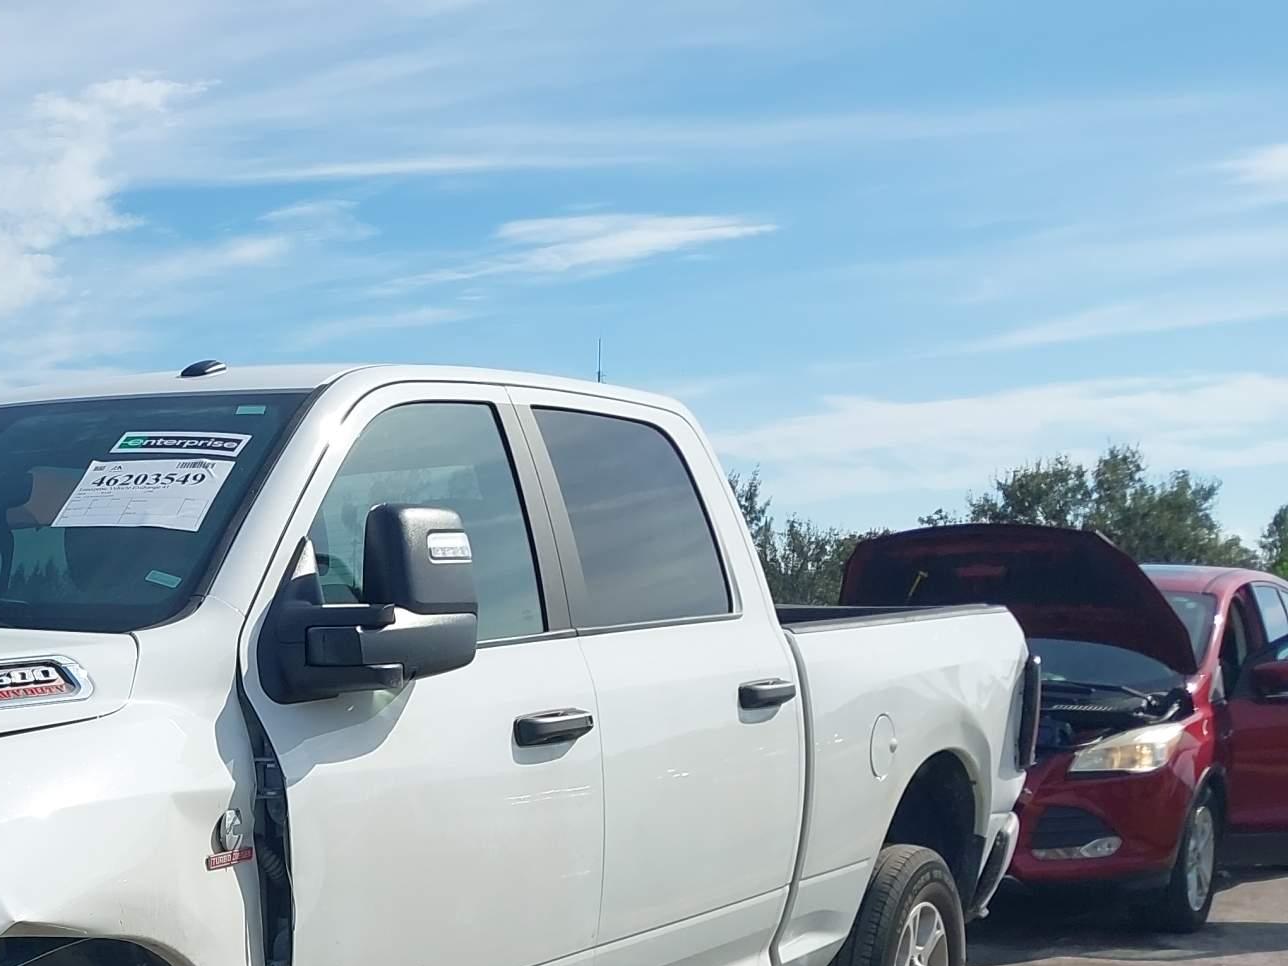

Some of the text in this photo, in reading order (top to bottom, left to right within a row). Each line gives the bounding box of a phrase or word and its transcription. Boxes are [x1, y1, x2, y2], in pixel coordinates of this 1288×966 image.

[123, 437, 238, 449] enterprise
[92, 473, 206, 487] 46203549
[25, 685, 66, 697] DUTY
